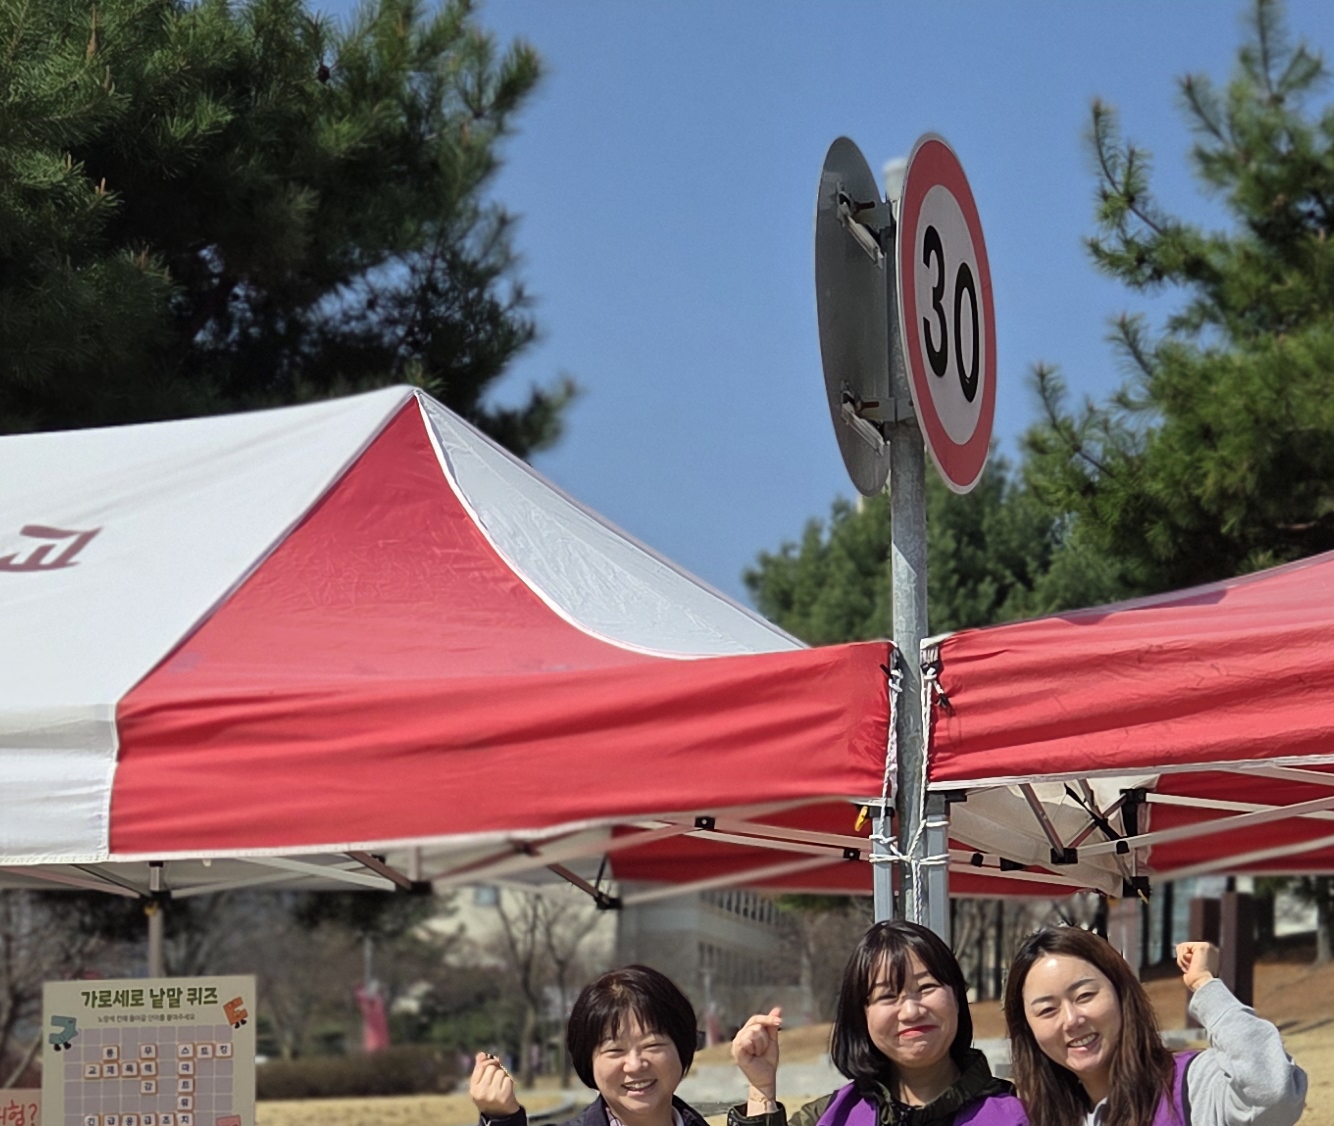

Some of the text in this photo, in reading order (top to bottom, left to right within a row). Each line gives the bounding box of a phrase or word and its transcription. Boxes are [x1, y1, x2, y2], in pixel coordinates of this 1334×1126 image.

[923, 224, 979, 402] 30
[82, 987, 218, 1009] 가로세로 낱말 퀴즈
